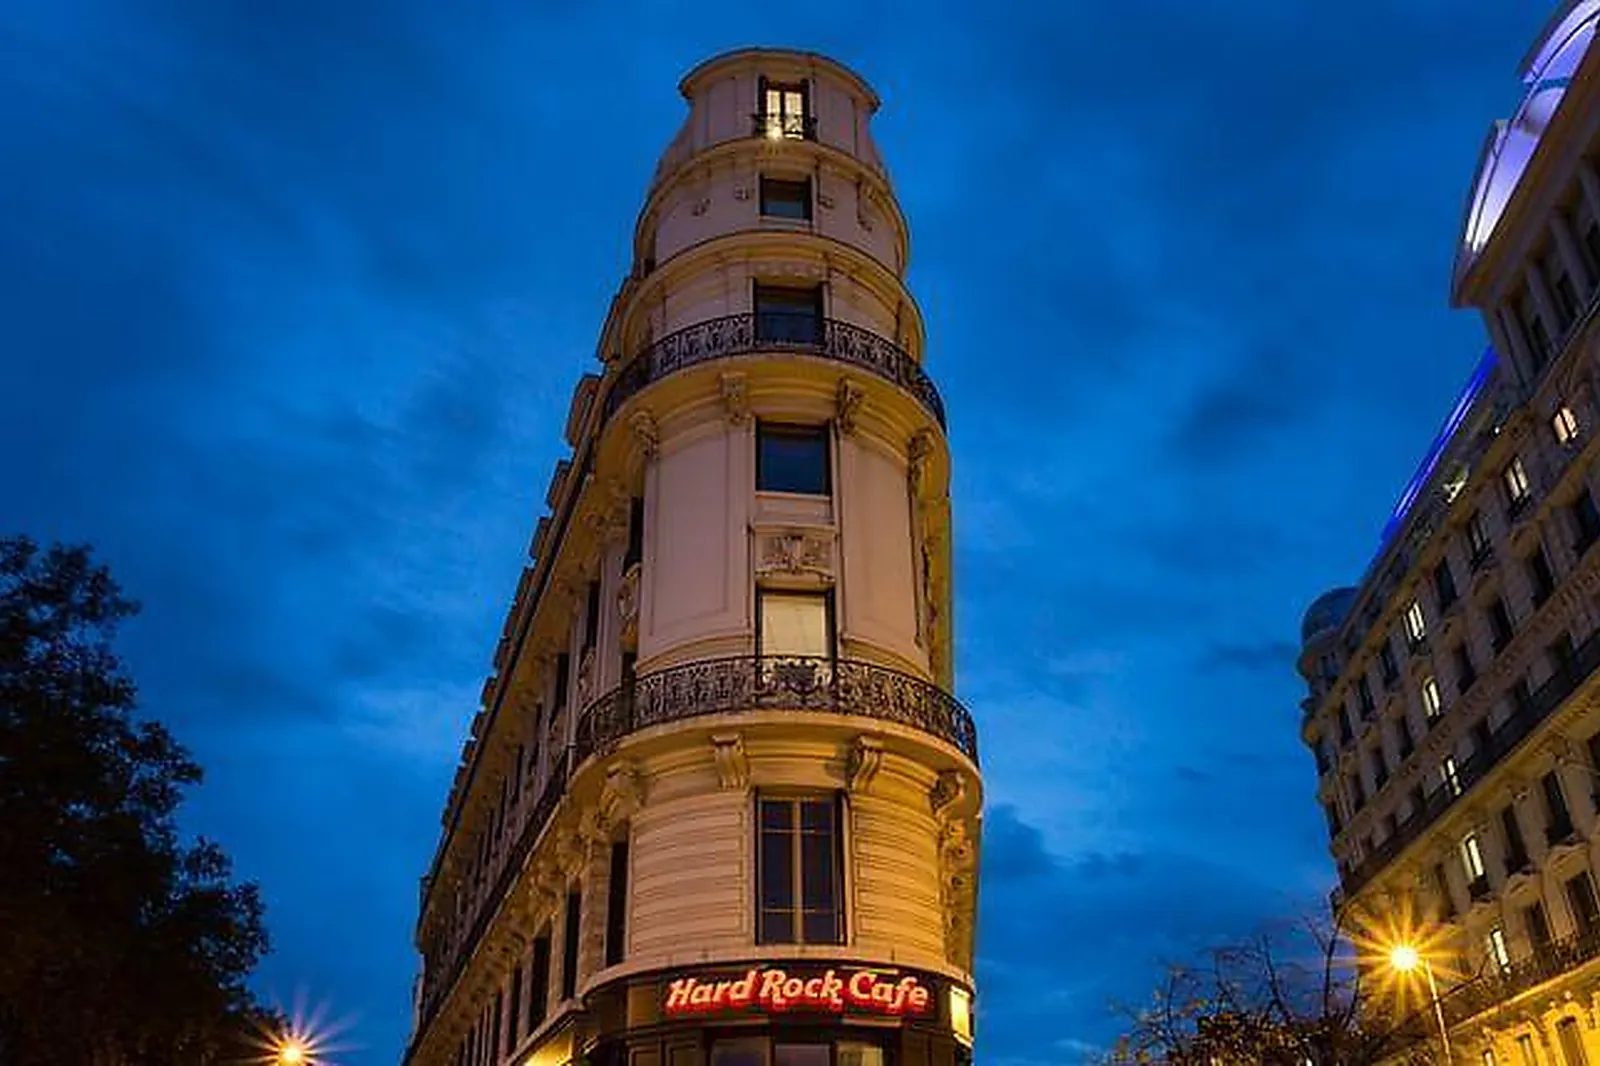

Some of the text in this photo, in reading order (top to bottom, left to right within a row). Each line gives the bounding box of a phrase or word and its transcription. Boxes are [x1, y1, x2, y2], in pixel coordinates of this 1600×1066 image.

[666, 969, 929, 1010] Hard Rock Cafe
